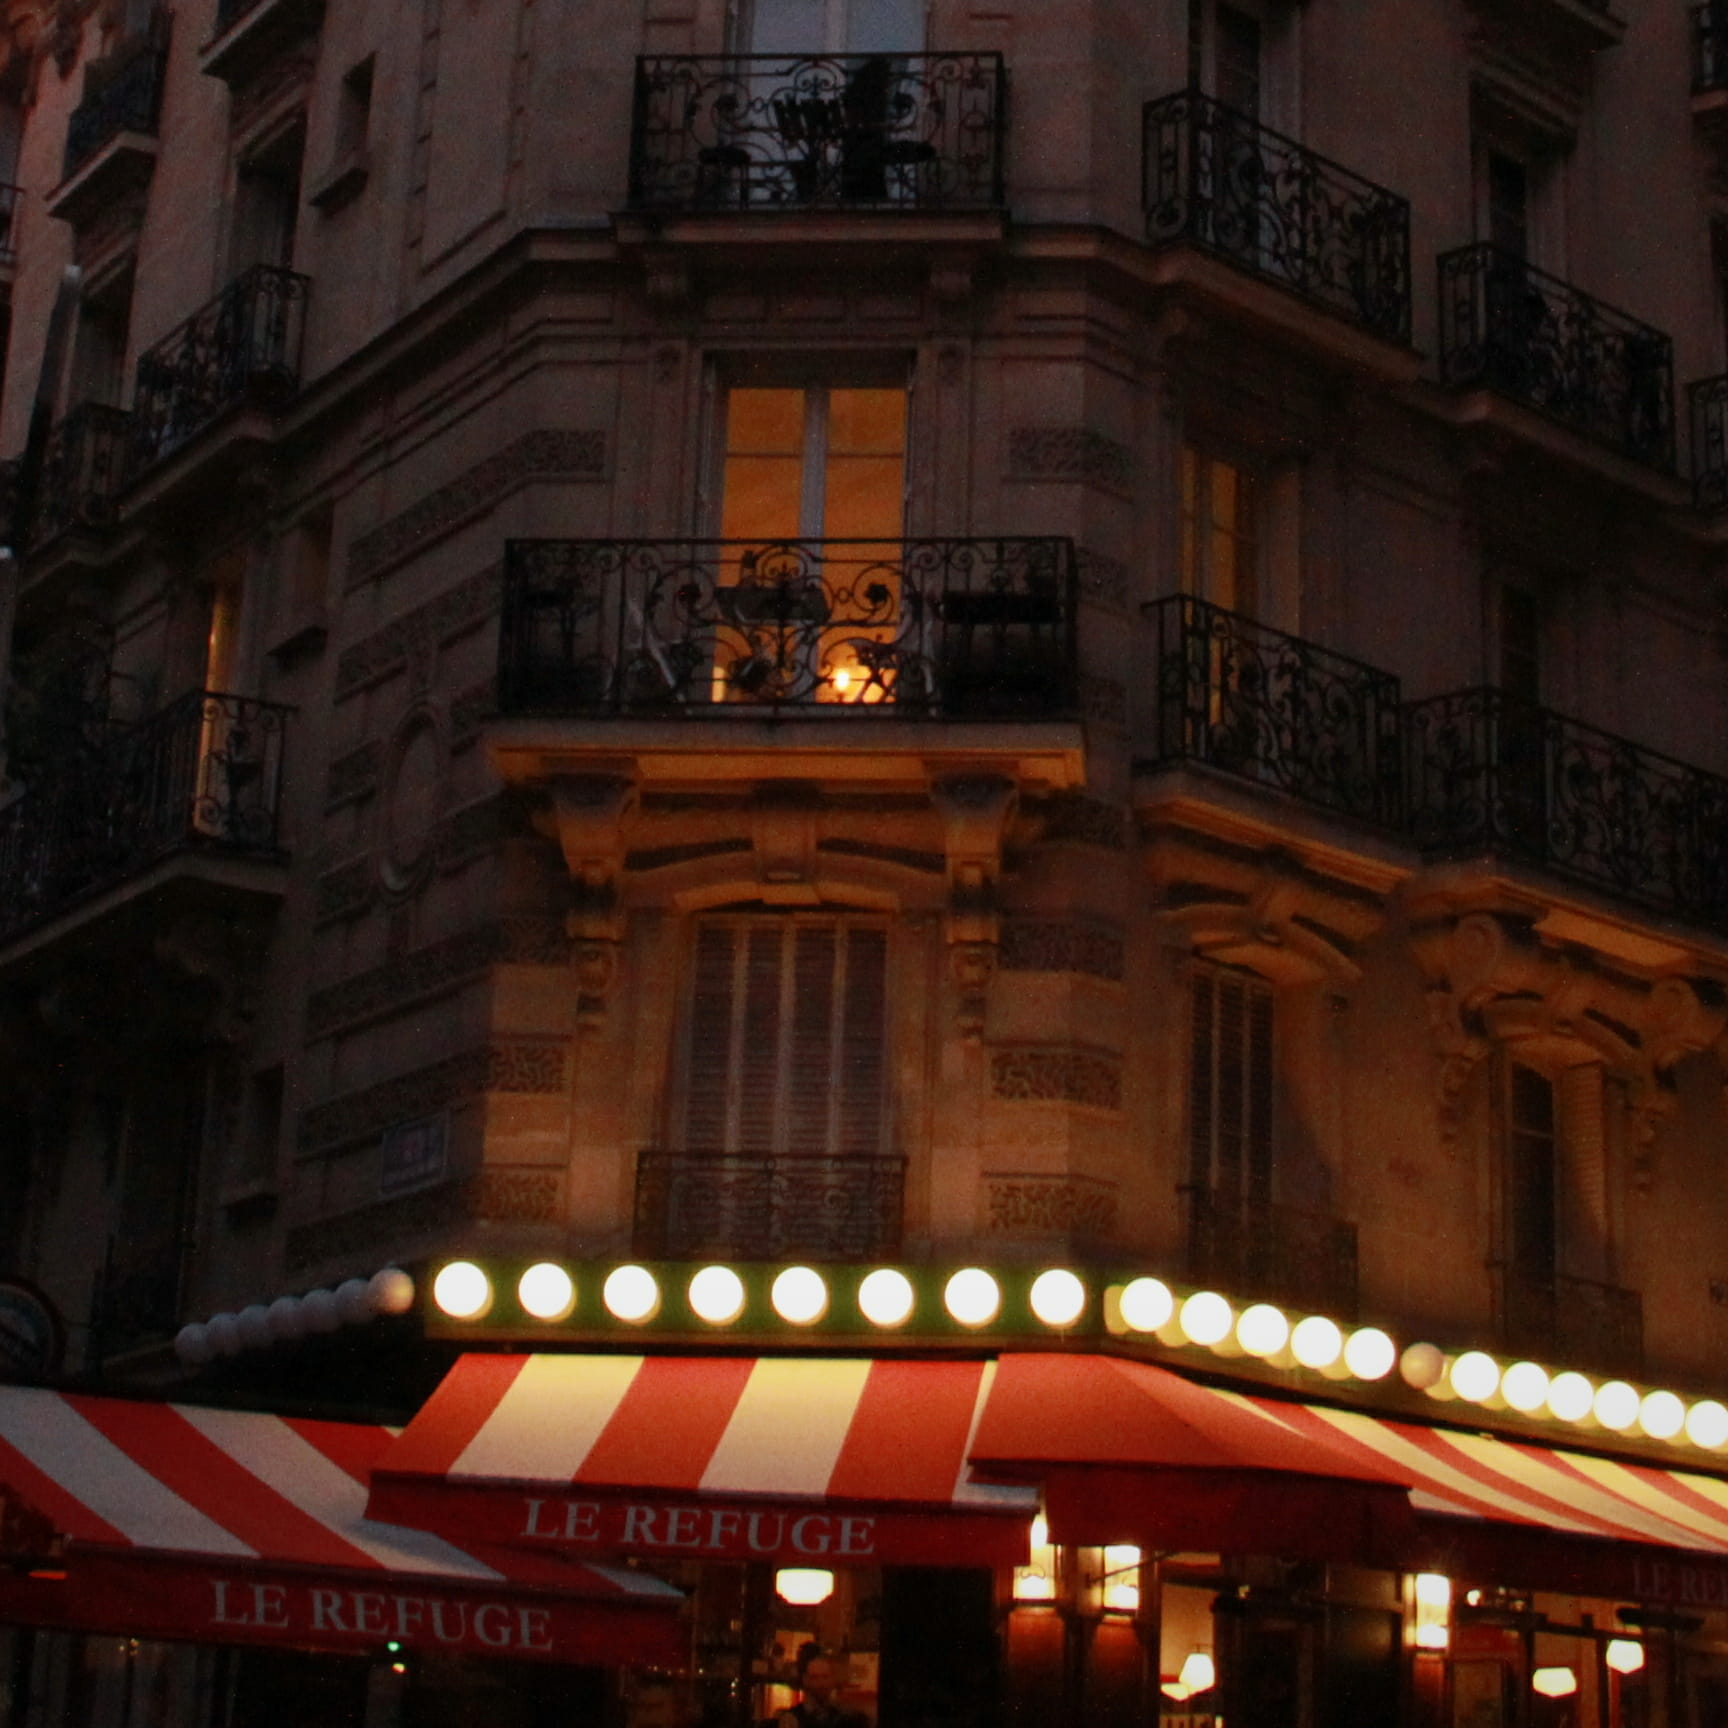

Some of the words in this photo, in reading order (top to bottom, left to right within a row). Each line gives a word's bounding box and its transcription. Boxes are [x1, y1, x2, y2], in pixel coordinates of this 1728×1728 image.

[519, 1498, 603, 1543] LE
[621, 1502, 877, 1557] REFUGE
[1630, 1556, 1674, 1601] LE
[210, 1579, 290, 1630] LE
[311, 1587, 555, 1653] REFUGE
